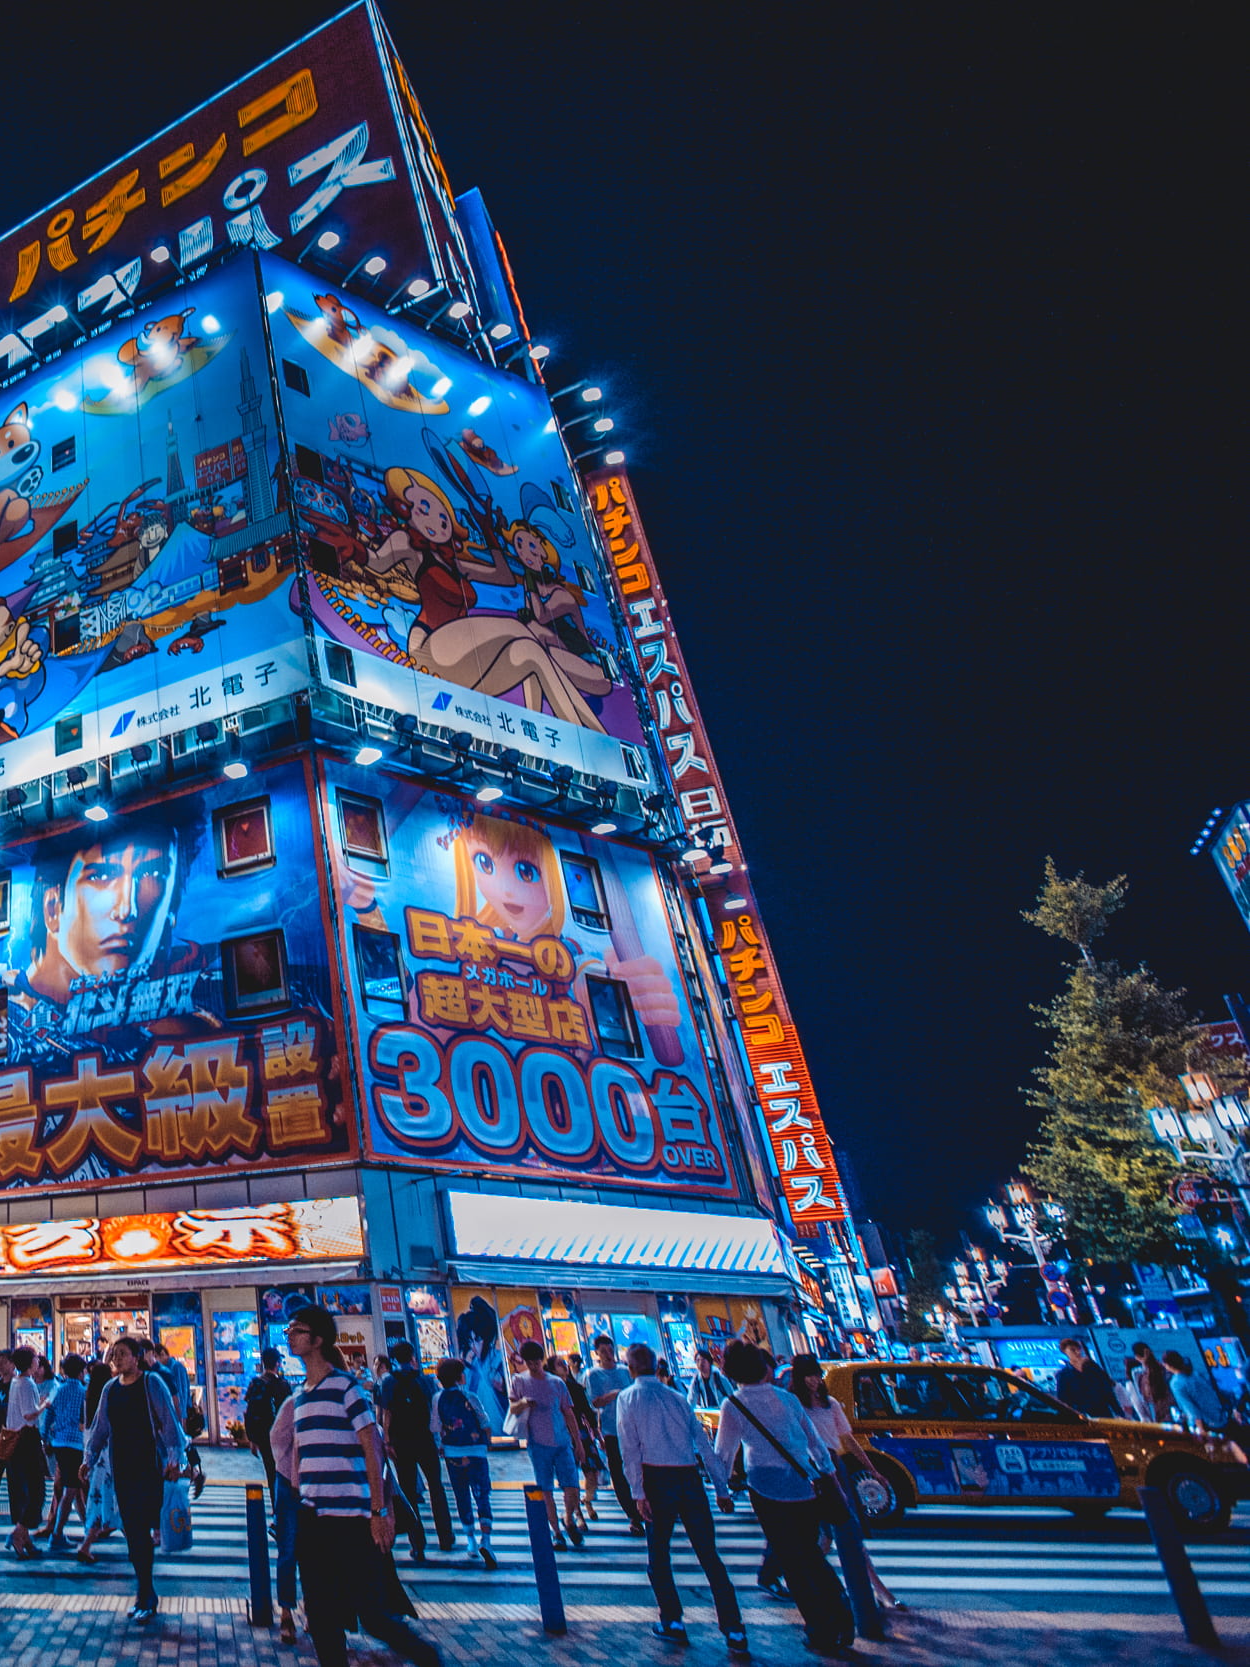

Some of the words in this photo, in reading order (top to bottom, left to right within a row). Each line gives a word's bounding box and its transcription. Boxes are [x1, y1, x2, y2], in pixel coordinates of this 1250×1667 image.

[9, 68, 318, 302] パチンコ
[596, 476, 651, 595] パチンコ
[137, 704, 181, 729] 株式会社
[189, 660, 278, 710] 北電子
[455, 705, 492, 727] 株式会社
[496, 711, 562, 748] 北電子
[628, 597, 710, 784] エスパス
[409, 910, 572, 979] 日本一の
[465, 963, 548, 997] メガホール
[721, 914, 785, 1046] パチンコ
[421, 976, 590, 1045] 超大型店
[261, 1022, 326, 1146] 設置
[375, 1029, 707, 1165] 3000台
[759, 1061, 837, 1213] エスパス
[662, 1144, 718, 1170] OVER
